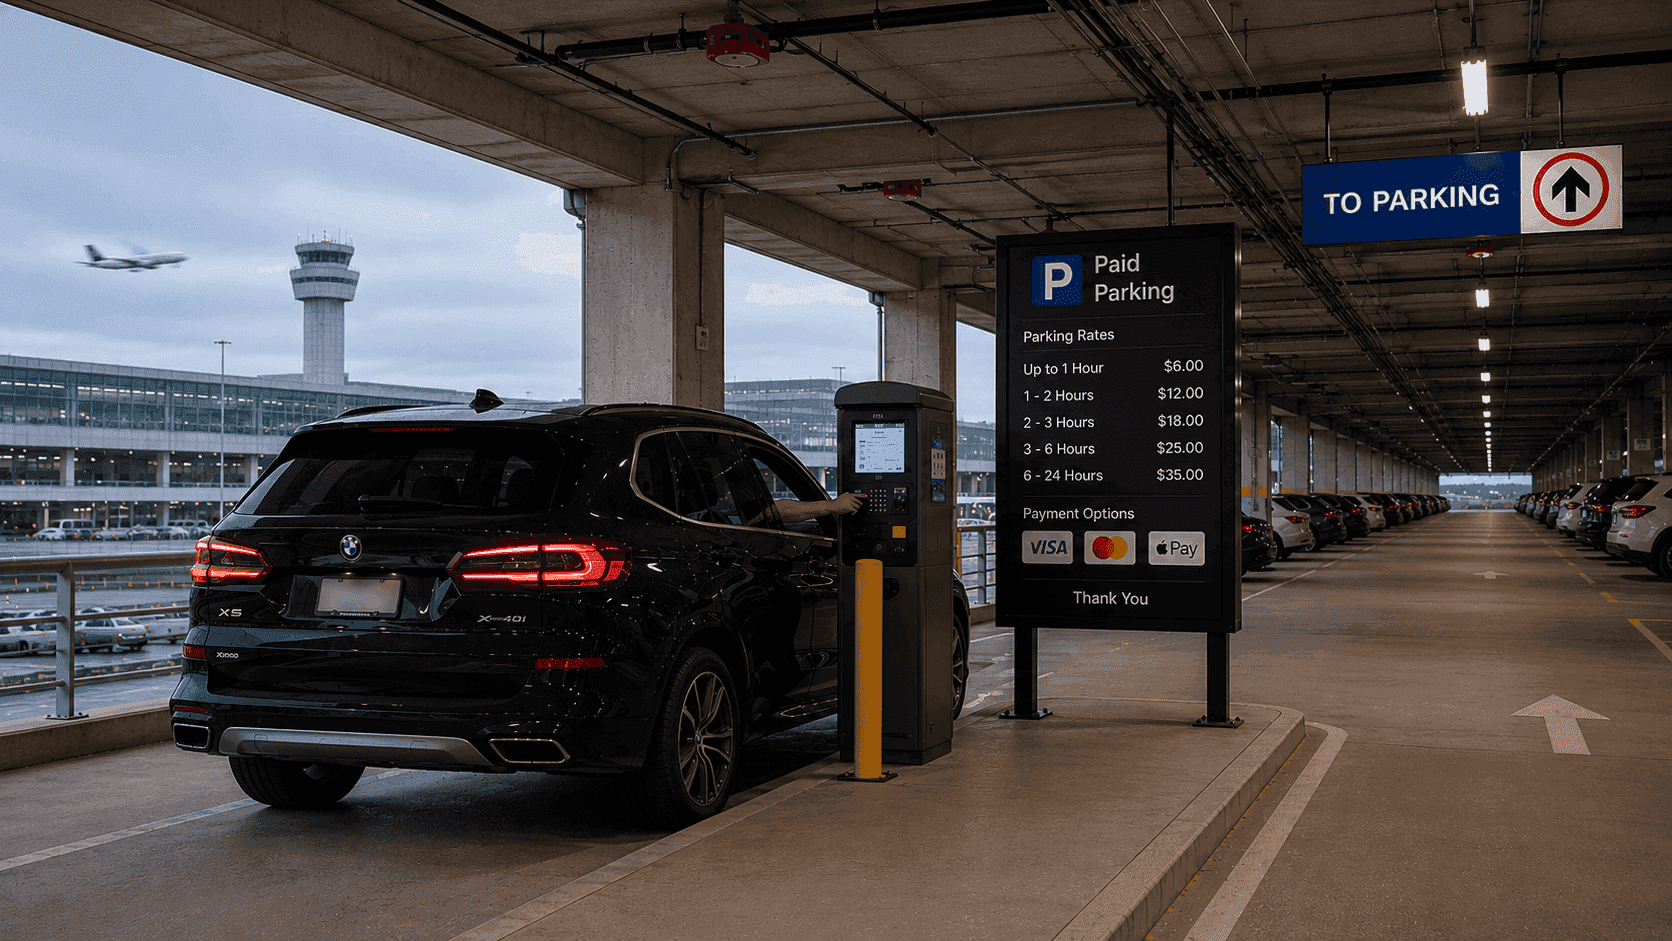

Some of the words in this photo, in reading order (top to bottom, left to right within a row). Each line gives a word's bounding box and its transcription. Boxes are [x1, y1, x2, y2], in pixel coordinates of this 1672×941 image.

[1323, 192, 1362, 215] TO
[1373, 183, 1500, 212] PARKING
[1095, 252, 1140, 274] Paid
[1044, 262, 1073, 300] P
[1094, 281, 1174, 304] Parking
[1023, 329, 1074, 345] Parking
[1077, 328, 1115, 341] Rates
[1023, 363, 1042, 378] Up
[1044, 363, 1059, 375] to
[1061, 362, 1068, 375] 1
[1072, 362, 1105, 374] Hour
[1163, 358, 1204, 374] $6.00
[1023, 390, 1029, 402] 1
[1043, 389, 1052, 402] 2
[1055, 389, 1094, 402] Hours
[1157, 386, 1204, 401] $12.00
[1023, 416, 1032, 429] 2
[1044, 416, 1053, 429] 3
[1056, 416, 1095, 428] Hours
[1157, 413, 1204, 428] $18.00
[1023, 442, 1032, 455] 3
[1044, 442, 1053, 455] 6
[1057, 442, 1096, 455] Hours
[1156, 441, 1204, 455] $25.00
[1023, 469, 1032, 482] 6
[1044, 469, 1061, 482] 24
[1064, 469, 1104, 482] Hours
[1156, 468, 1204, 482] $35.00
[1023, 507, 1080, 523] Payment
[1082, 507, 1135, 523] Options
[1028, 539, 1068, 555] VISA
[1170, 540, 1199, 559] Pay
[1072, 590, 1118, 605] Thank
[1121, 591, 1149, 606] You
